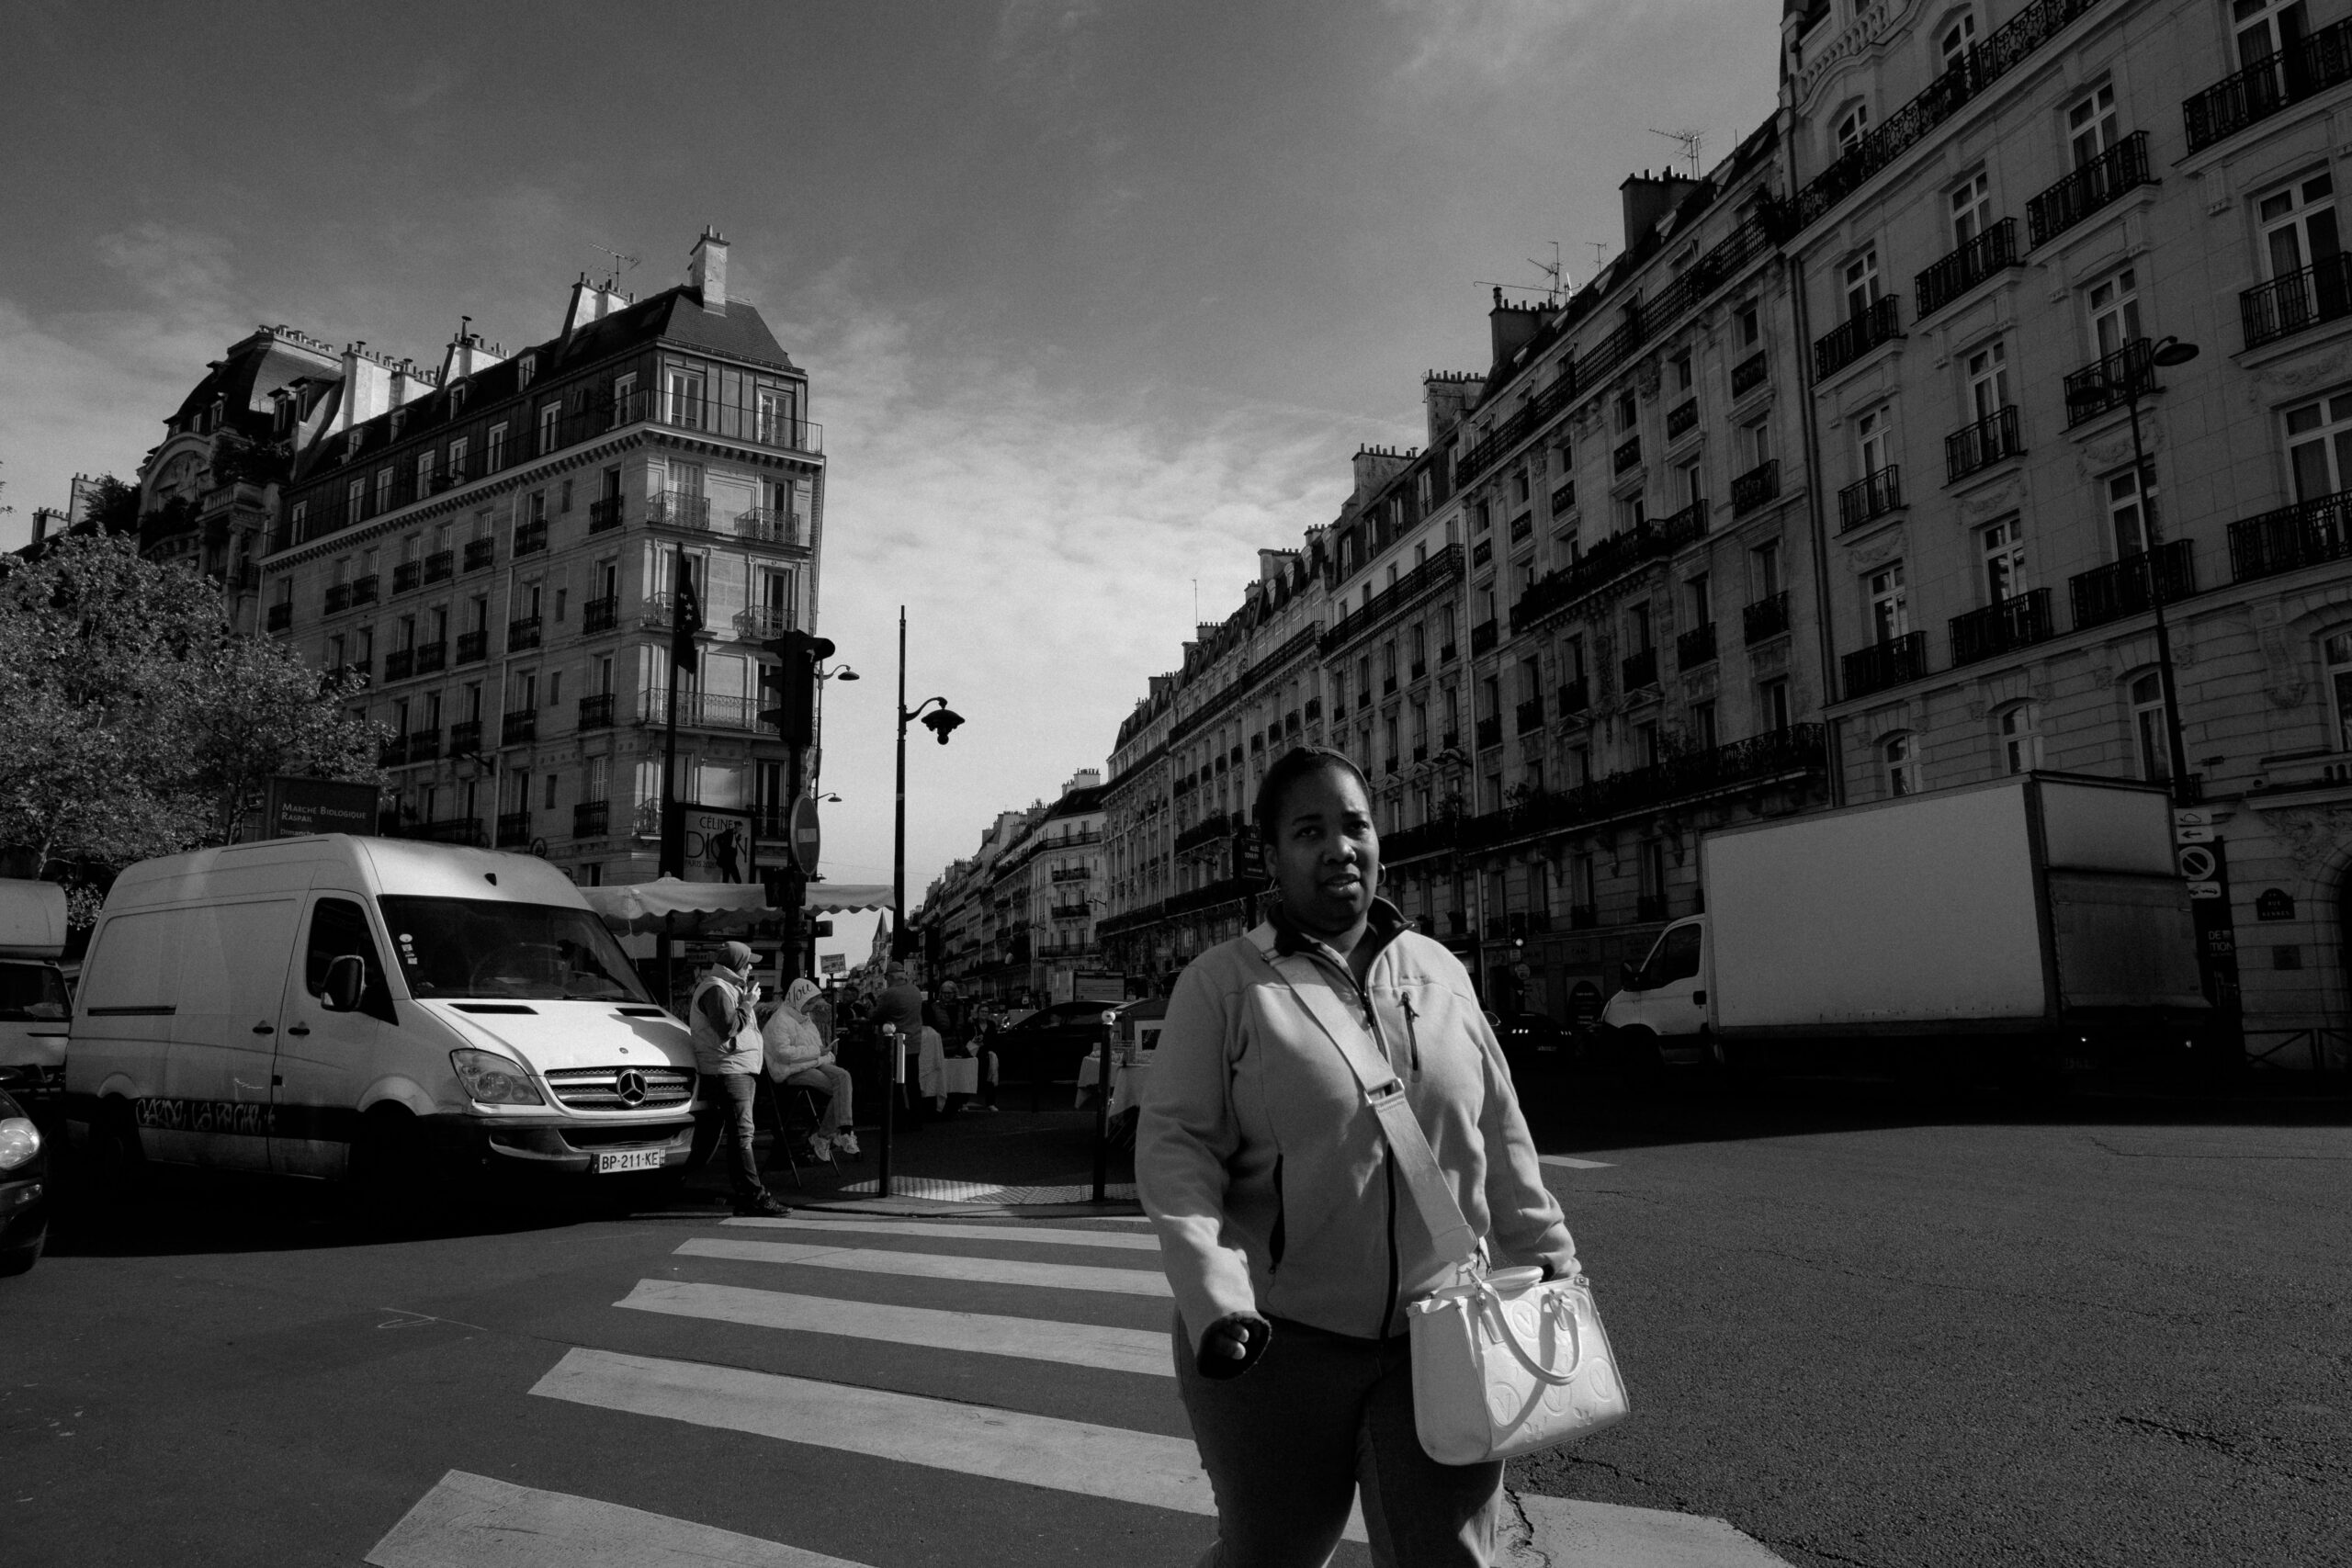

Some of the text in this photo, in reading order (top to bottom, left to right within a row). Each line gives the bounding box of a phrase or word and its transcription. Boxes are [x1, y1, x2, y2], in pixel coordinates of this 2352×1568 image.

[281, 812, 313, 823] RASPAIL
[320, 806, 368, 819] BIOLOGIQUE
[699, 815, 733, 830] CÉLINE
[602, 1152, 659, 1169] BP-211-KE
